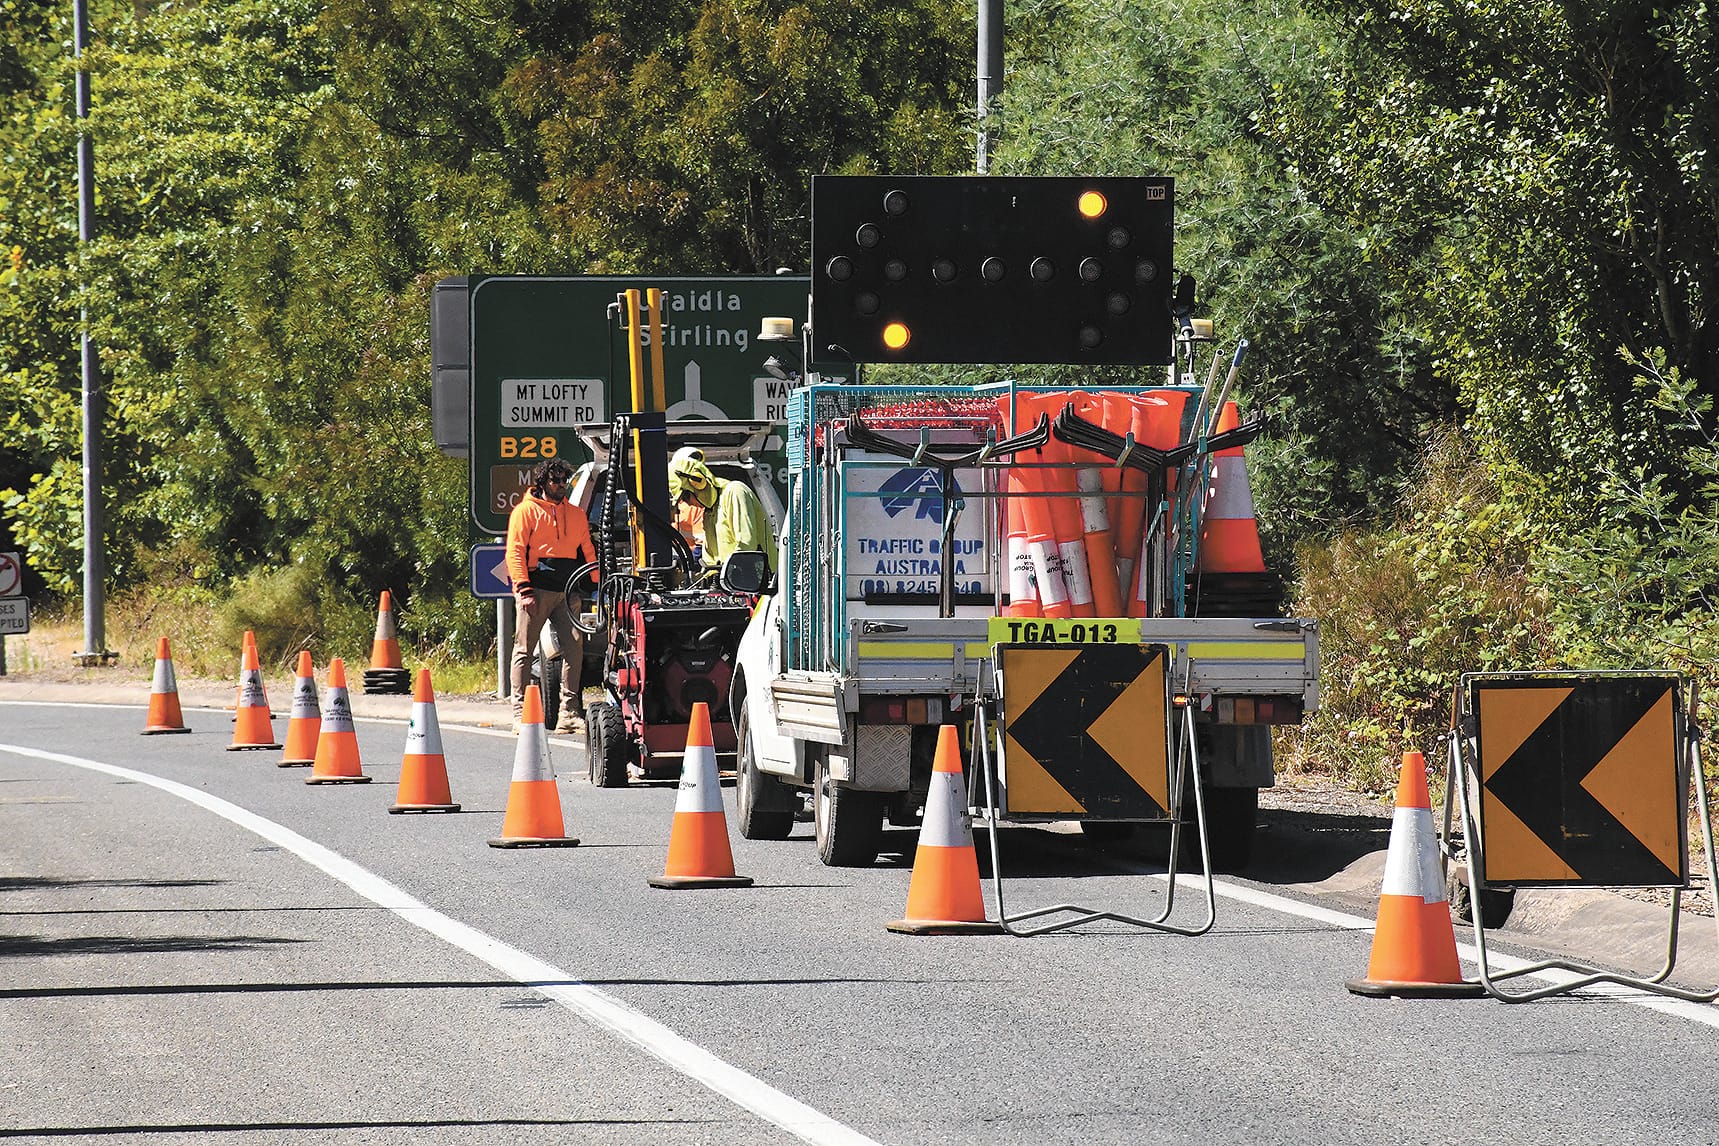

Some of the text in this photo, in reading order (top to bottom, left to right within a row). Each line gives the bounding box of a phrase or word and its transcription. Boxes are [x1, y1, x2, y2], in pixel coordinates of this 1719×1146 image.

[1148, 188, 1164, 198] TOP
[517, 385, 588, 400] MT LOFTY
[511, 407, 595, 422] SUMMIT RD
[500, 437, 557, 458] B28
[858, 539, 984, 554] TRAFFIC GOUP
[875, 560, 966, 575] AUSTRAA
[896, 580, 937, 594] 8245
[1008, 622, 1117, 643] TGA-013
